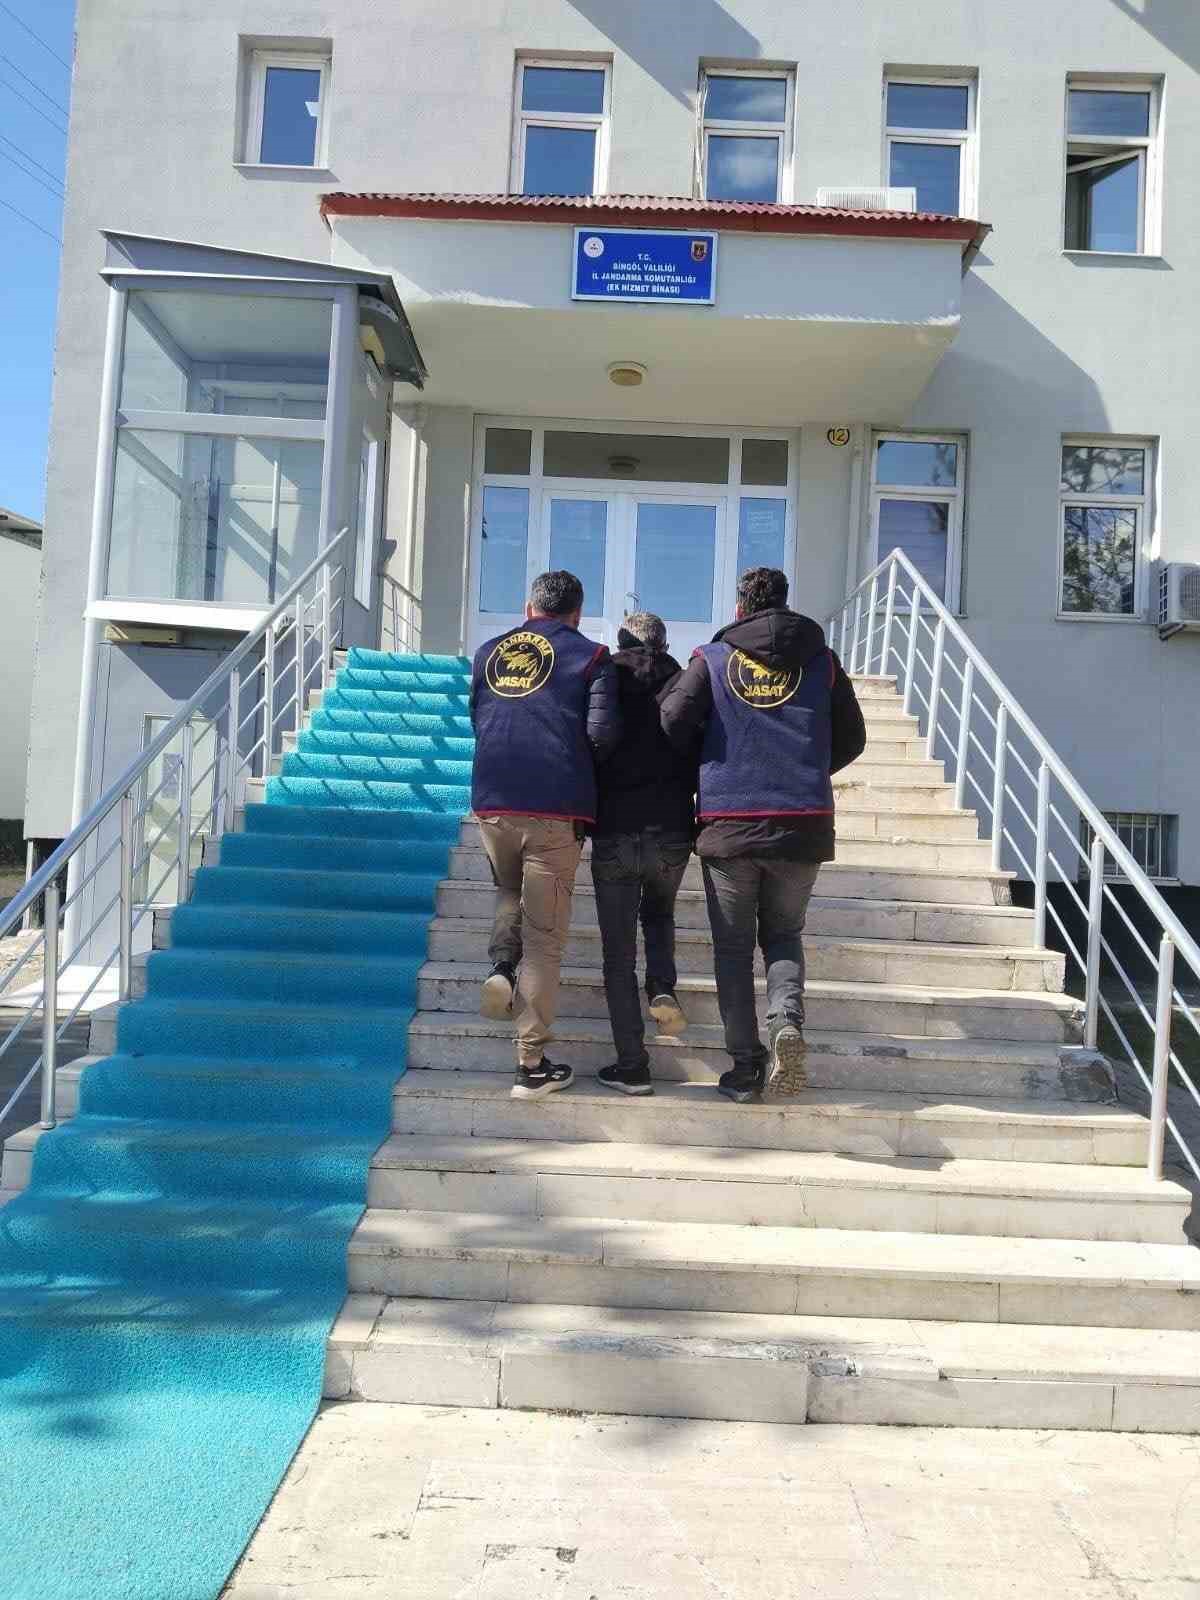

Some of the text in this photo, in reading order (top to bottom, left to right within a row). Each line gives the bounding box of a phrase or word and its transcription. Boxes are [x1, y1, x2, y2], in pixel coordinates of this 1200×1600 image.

[637, 253, 652, 261] T.C.
[601, 272, 642, 281] JANDARMA
[832, 428, 845, 442] 12
[499, 634, 552, 656] JANDARMA
[495, 676, 533, 689] JASAT
[743, 685, 785, 697] JASAT
